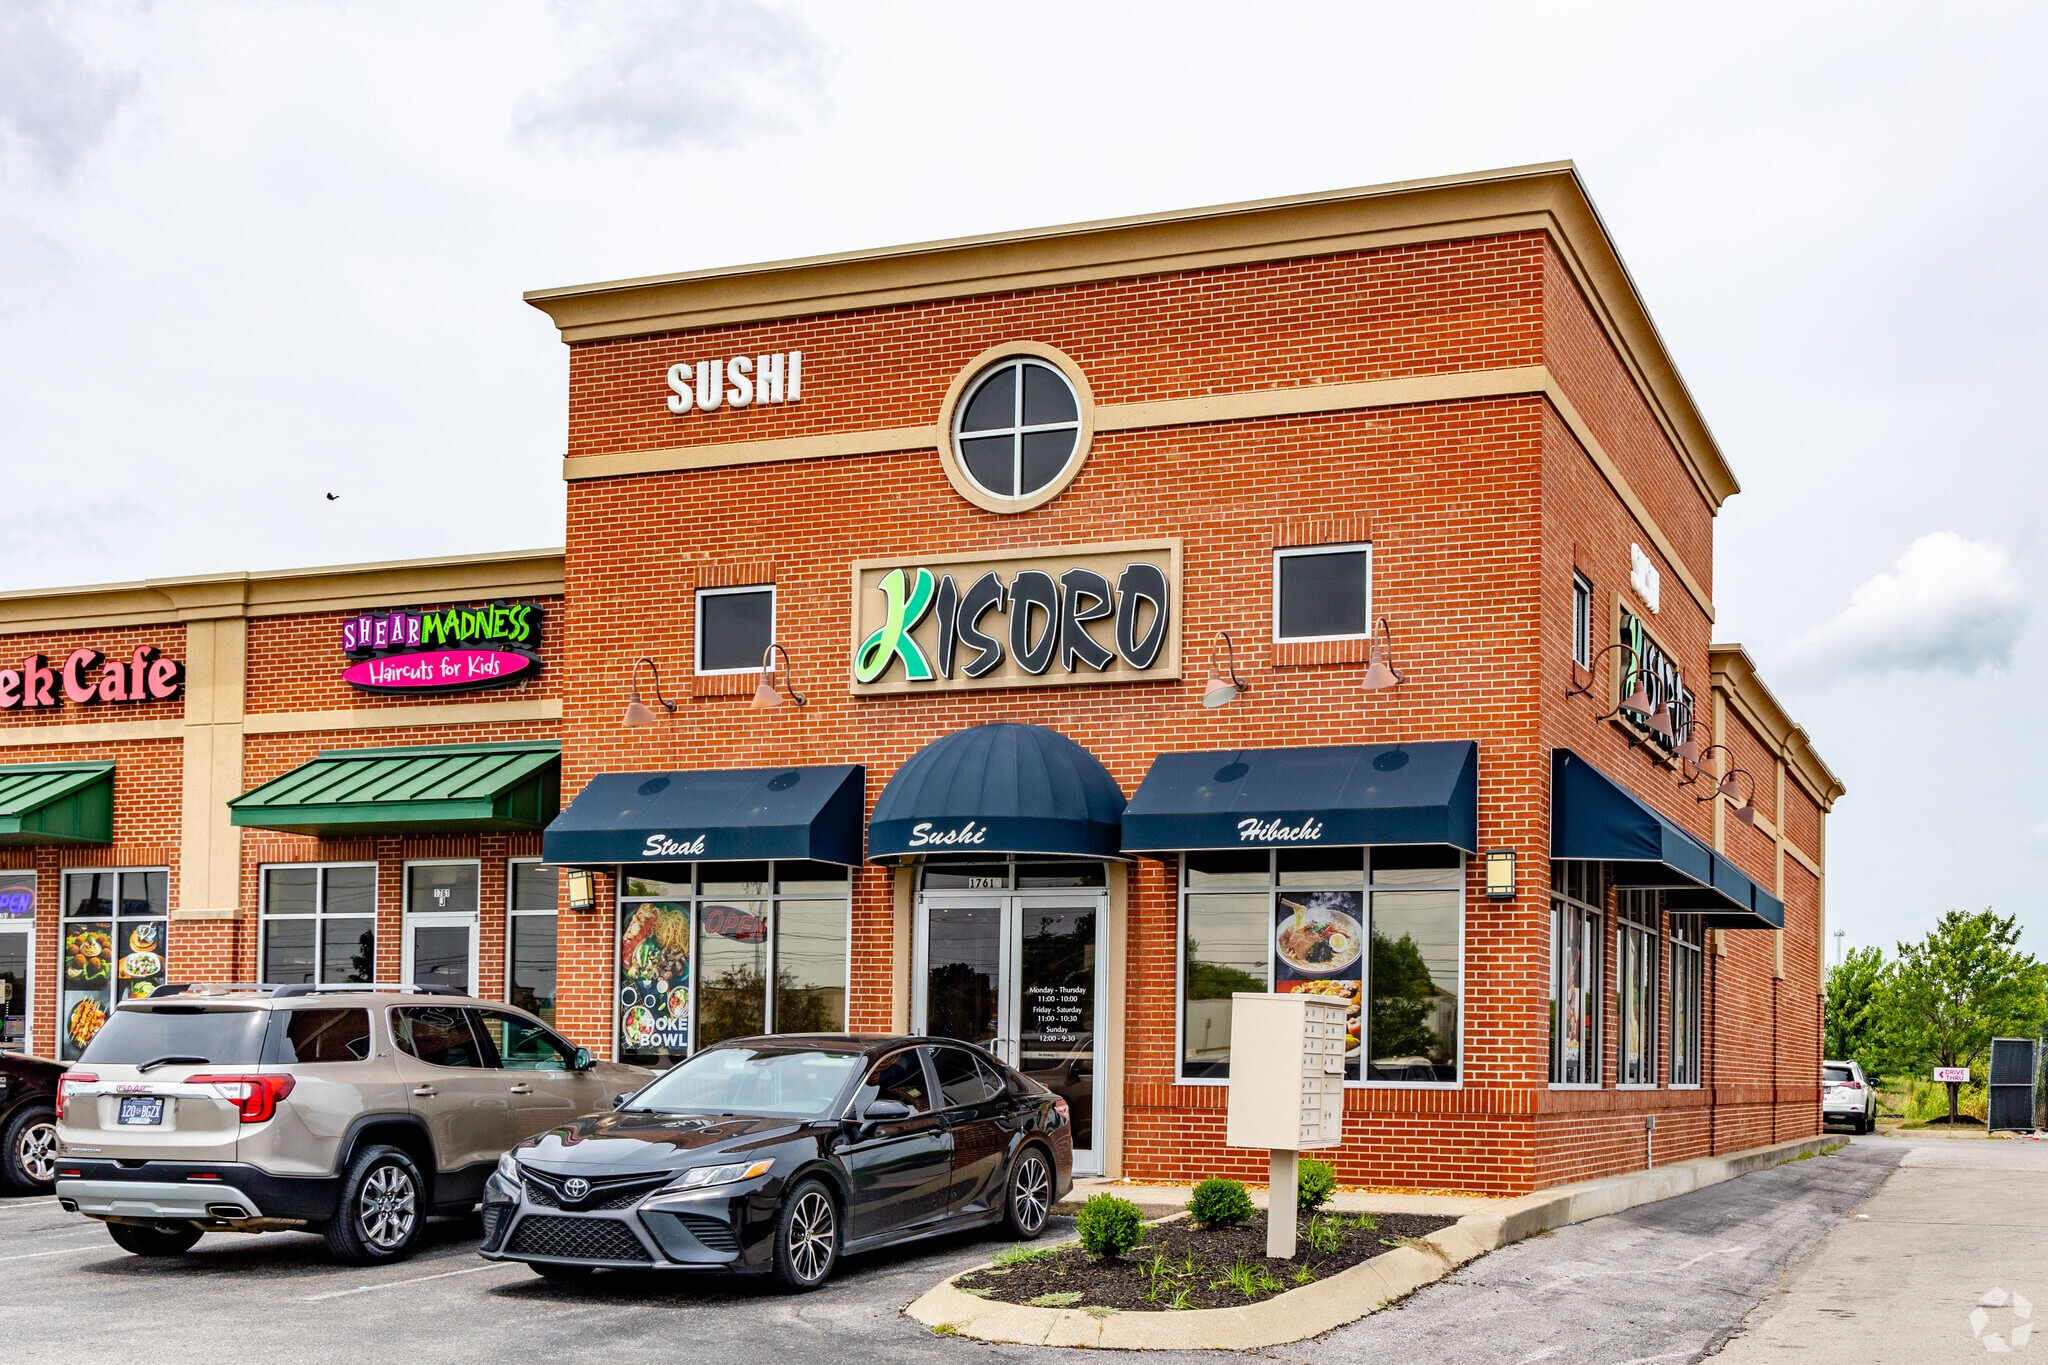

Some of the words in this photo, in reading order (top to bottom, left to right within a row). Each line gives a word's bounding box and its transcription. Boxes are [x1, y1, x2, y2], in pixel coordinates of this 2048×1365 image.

[666, 350, 802, 415] SUSHI
[343, 613, 421, 650] SHEAR
[421, 604, 532, 644] MADNESS
[853, 562, 1170, 684] KISORO
[63, 644, 178, 703] Cafe
[369, 659, 434, 685] Haircuts
[439, 656, 462, 678] for
[468, 653, 501, 677] Kids
[908, 821, 987, 847] Sushi
[1237, 817, 1323, 842] Hibachi
[641, 833, 706, 857] Steak
[969, 878, 994, 889] 1761
[704, 909, 768, 942] OPEN
[1029, 986, 1054, 995] Monday
[1059, 986, 1086, 995] Thursday
[1038, 995, 1055, 1003] 11:00
[1060, 995, 1078, 1003] 10:00
[1032, 1006, 1052, 1014] Friday
[1056, 1006, 1083, 1014] Saturday
[646, 1016, 688, 1031] POKE
[1046, 1026, 1069, 1034] Sunday
[640, 1033, 688, 1047] BOWL
[116, 1084, 153, 1094] GMC
[121, 1104, 136, 1118] 120
